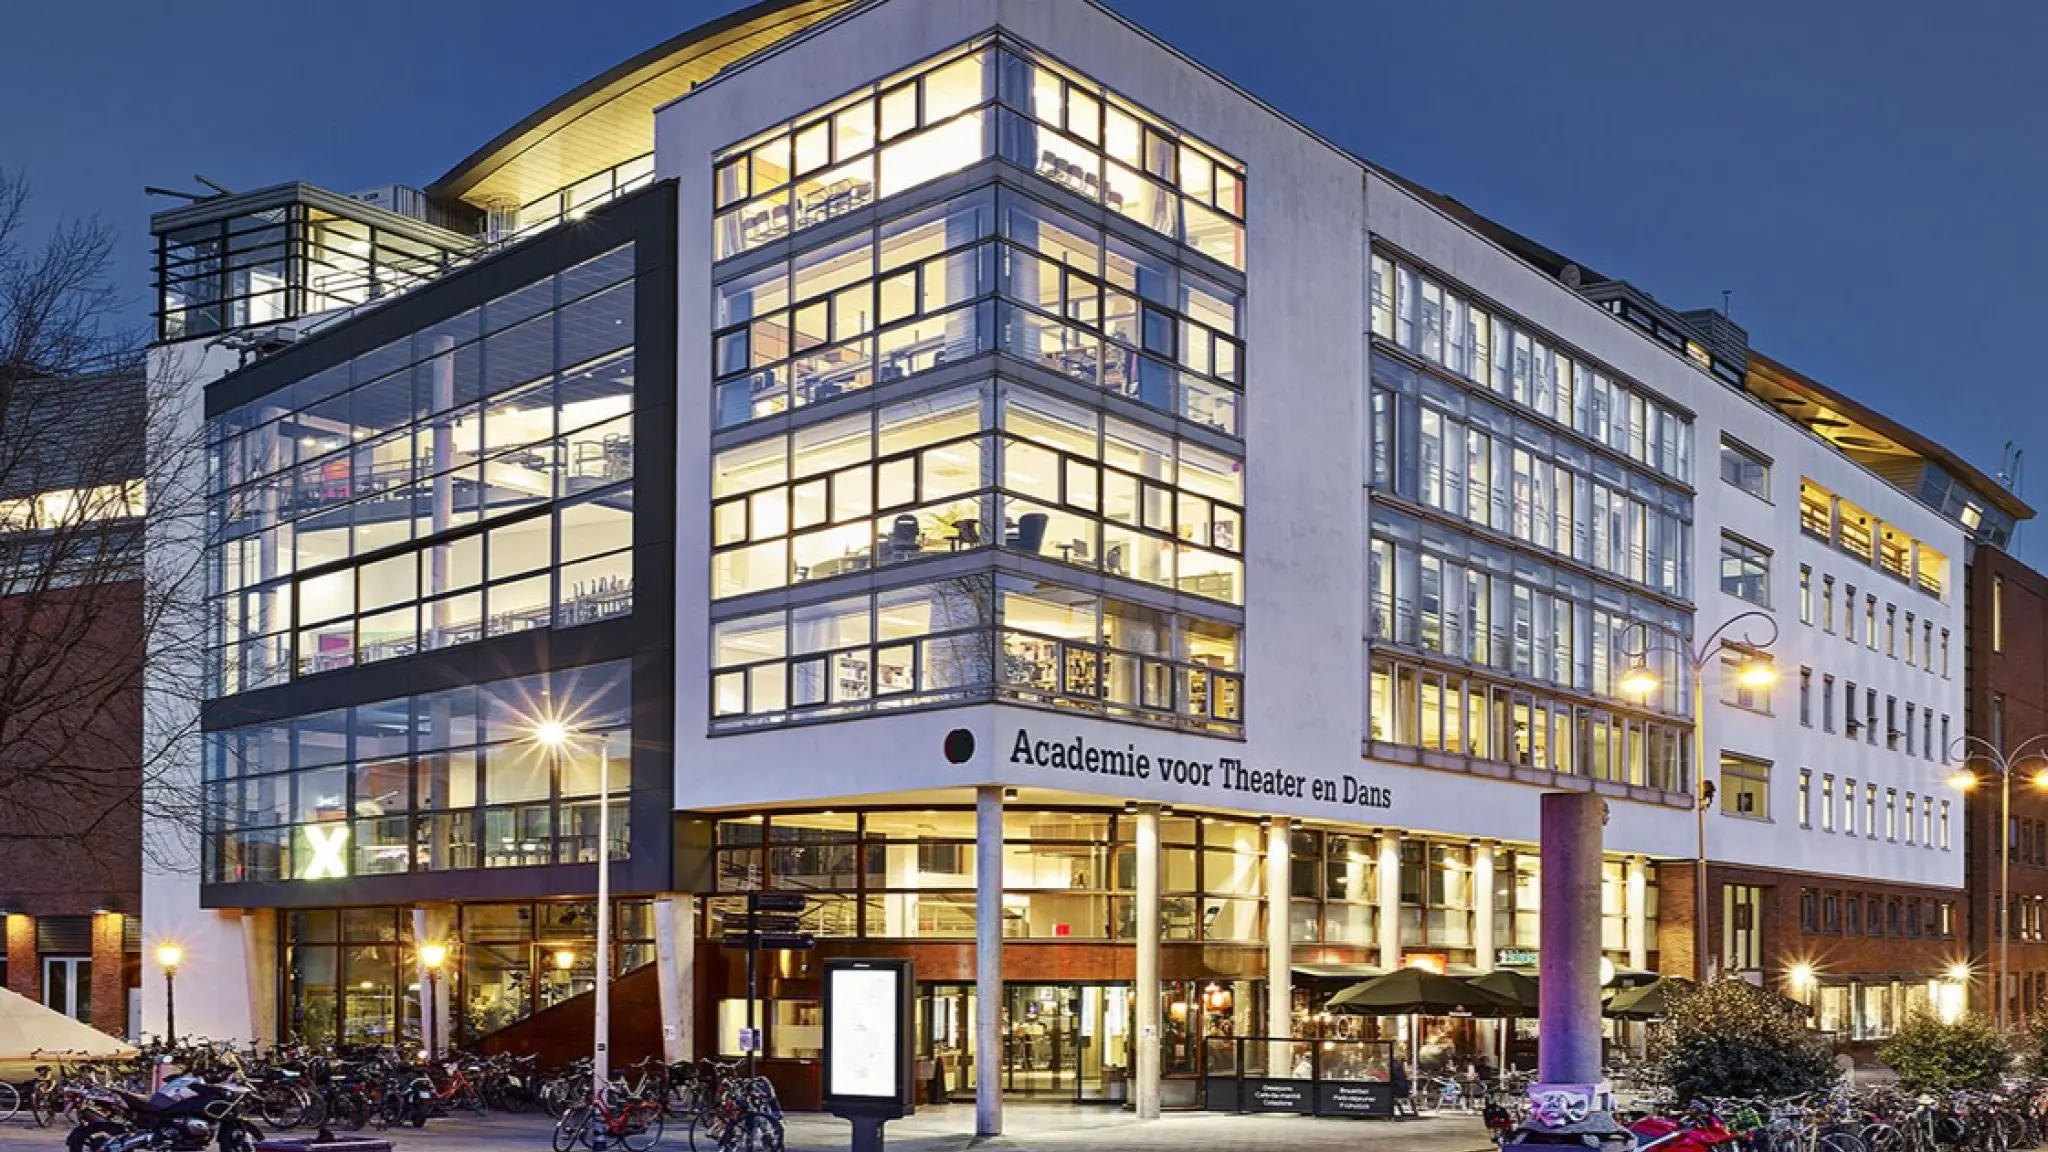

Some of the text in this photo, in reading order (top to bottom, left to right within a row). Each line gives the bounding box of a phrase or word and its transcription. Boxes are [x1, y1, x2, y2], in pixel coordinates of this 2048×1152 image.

[1010, 728, 1392, 809] Academie voor Theater en Dans
[304, 825, 350, 880] X
